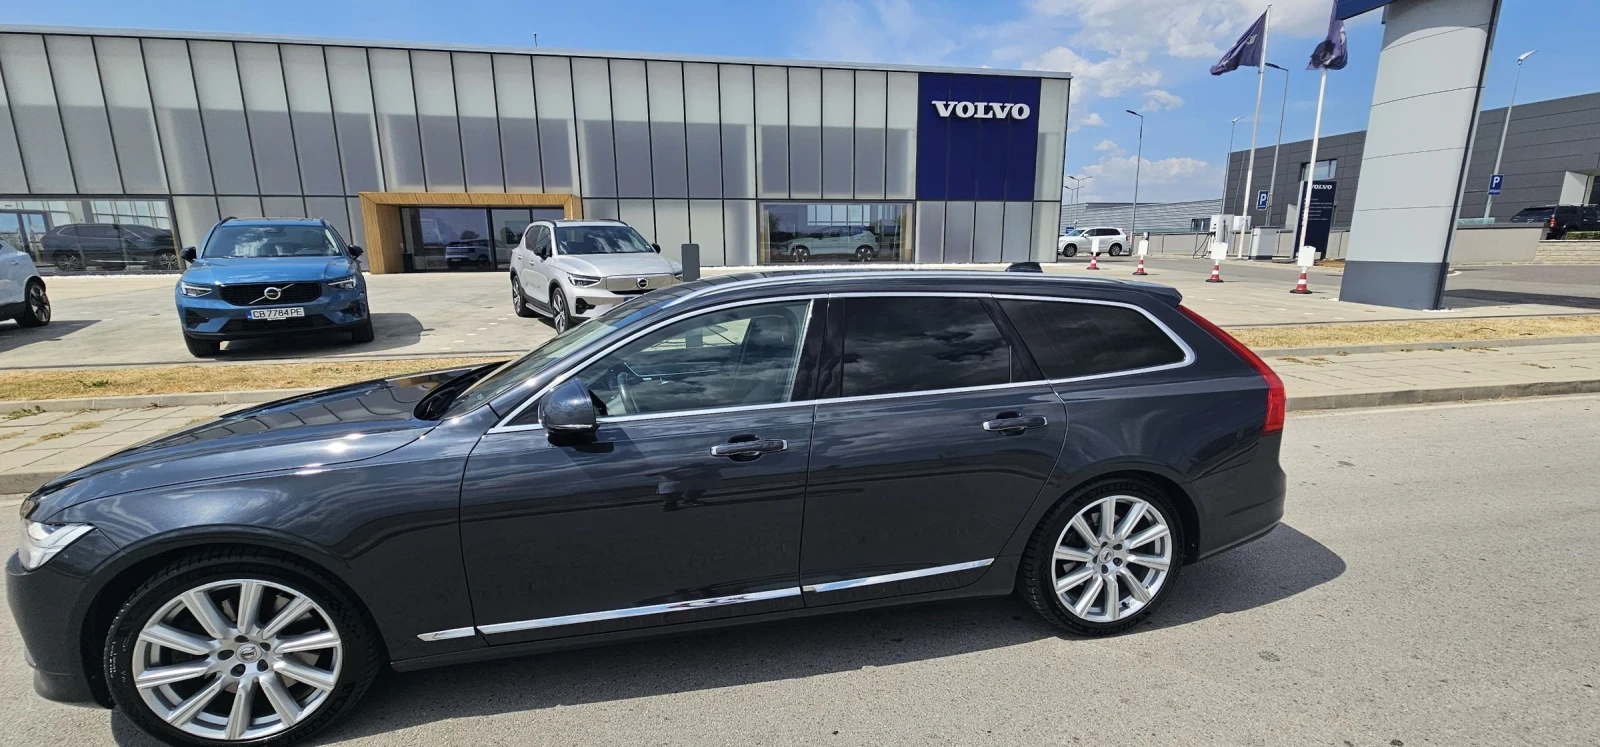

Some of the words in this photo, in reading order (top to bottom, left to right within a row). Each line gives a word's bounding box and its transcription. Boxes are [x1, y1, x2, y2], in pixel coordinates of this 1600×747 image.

[931, 100, 1030, 119] VOLVO
[1492, 176, 1500, 188] P
[1260, 194, 1266, 205] P
